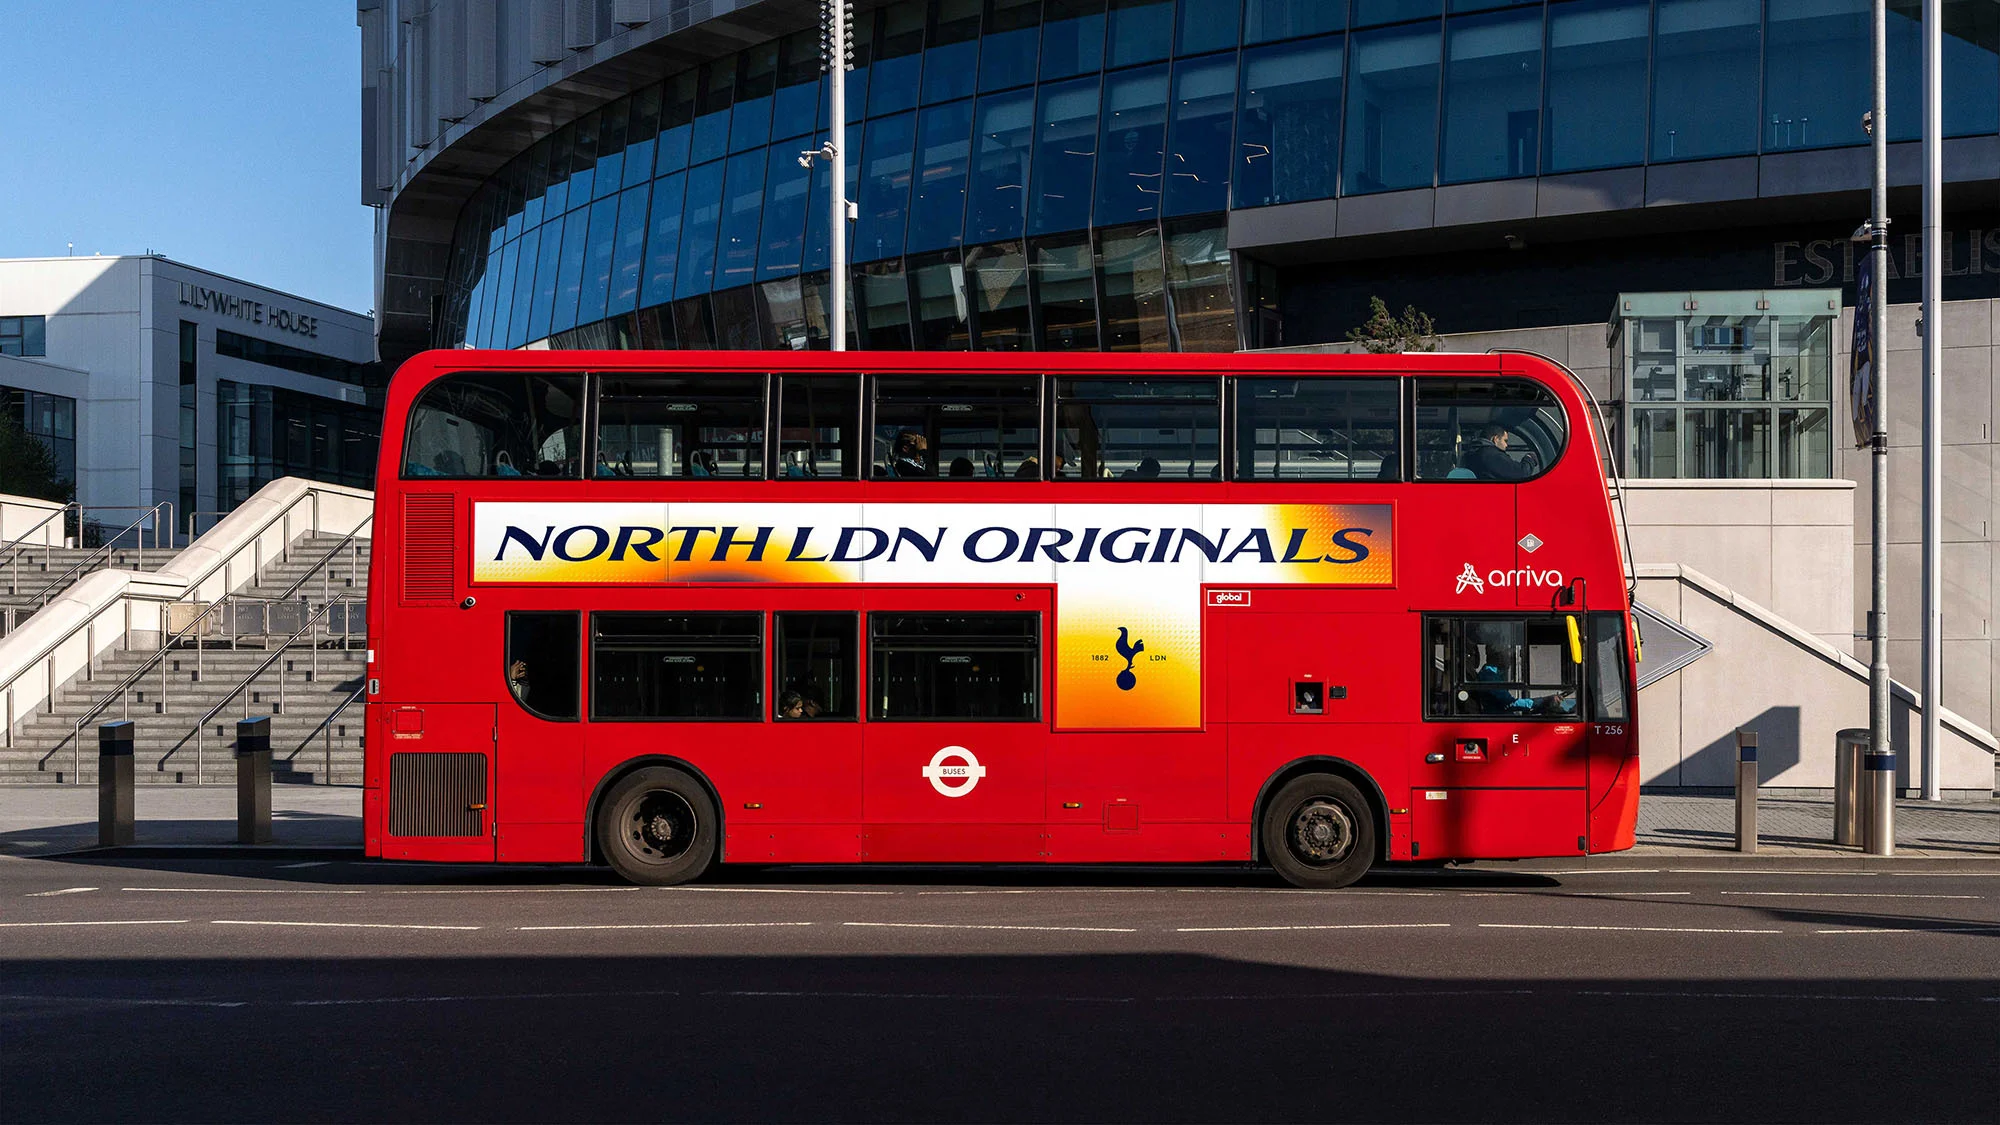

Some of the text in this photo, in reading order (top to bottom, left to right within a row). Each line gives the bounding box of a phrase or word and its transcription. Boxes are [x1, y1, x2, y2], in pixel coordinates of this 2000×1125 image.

[179, 281, 319, 338] LILYWHITE HOUSE
[493, 525, 1374, 564] NORTH LDN ORIGINALS
[1488, 565, 1563, 587] arriva
[1216, 593, 1242, 604] global
[337, 612, 360, 620] ERY
[1594, 725, 1623, 735] T 256
[1512, 734, 1519, 743] E
